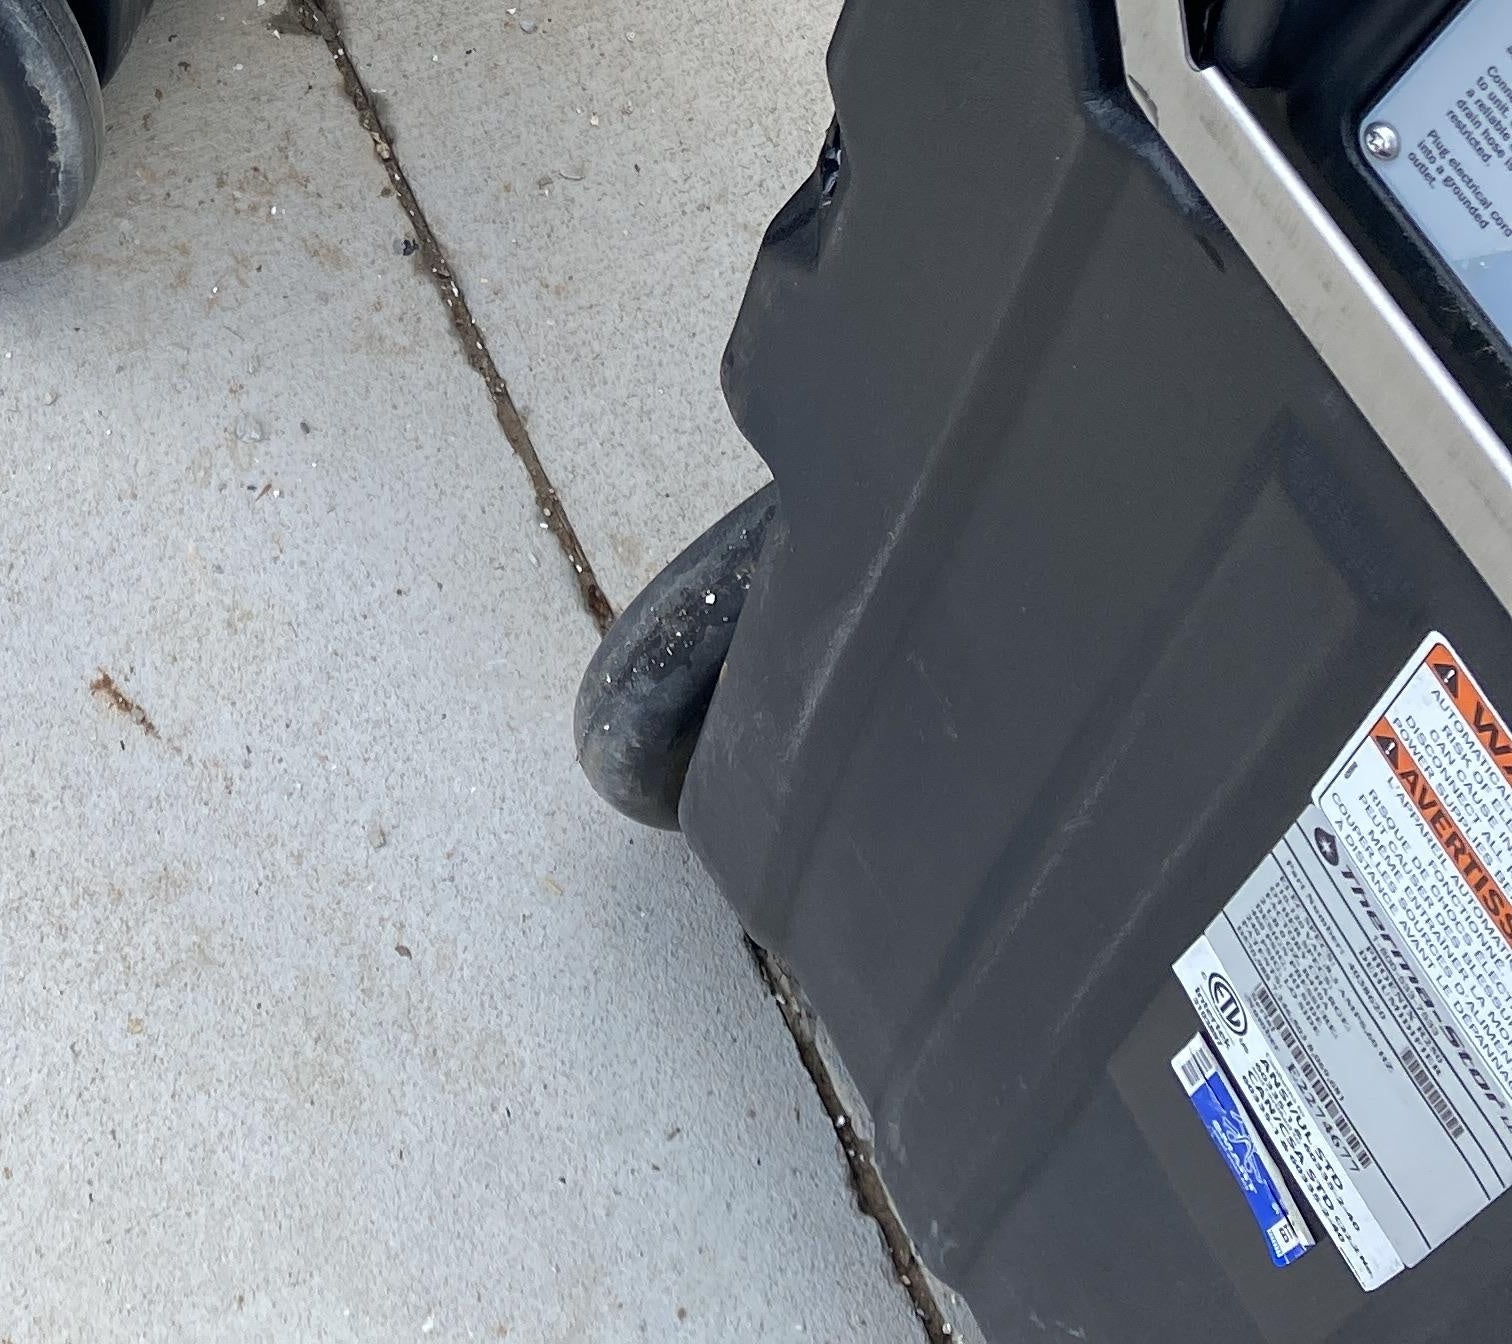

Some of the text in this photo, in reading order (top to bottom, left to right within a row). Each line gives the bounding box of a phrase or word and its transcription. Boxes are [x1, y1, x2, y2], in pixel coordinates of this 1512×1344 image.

[1454, 96, 1483, 130] drain
[1479, 127, 1508, 160] hose
[1464, 86, 1512, 142] a reliable
[1474, 74, 1512, 120] to unit.
[1485, 63, 1512, 103] Conn
[1405, 150, 1439, 190] outlet.
[1416, 139, 1489, 230] into a grounded
[1423, 128, 1452, 161] Plug
[1446, 155, 1493, 211] electrical
[1444, 108, 1494, 167] restricted.
[1390, 715, 1437, 780] POWER
[1433, 780, 1496, 867] SUPPLIES
[1403, 714, 1507, 862] DISCONNECT ALL
[1427, 727, 1456, 767] CAN
[1454, 766, 1500, 830] CAUSE
[1439, 722, 1474, 769] RISK
[1471, 768, 1492, 796] OF
[1284, 858, 1306, 890] Part
[1303, 891, 1346, 955] Number:
[1329, 789, 1376, 859] COUPER
[1373, 860, 1398, 895] LES
[1396, 895, 1454, 980] SOURCES
[1343, 832, 1400, 915] DISTANCE
[1398, 917, 1435, 970] AVANT
[1435, 973, 1454, 998] LE
[1357, 792, 1389, 838] PEUT
[1386, 838, 1435, 910] CAUSER
[1433, 911, 1462, 950] DES
[1365, 787, 1512, 1010] RISQUE DE CHOCS ÉLECT
[1384, 774, 1512, 965] L'APPAREIL AUTOMATI
[1193, 985, 1233, 1050] Intertek
[1338, 862, 1503, 1109] Therma-Stor
[1357, 948, 1441, 1076] DEHUMIDIFIER
[1363, 944, 1416, 1022] PHOENIX
[1468, 983, 1488, 1009] LA
[1209, 1117, 1259, 1197] SMART
[1245, 1067, 1307, 1166] CAN/CSA
[1305, 1167, 1336, 1213] STD
[1258, 1054, 1345, 1193] ANSI/UL STD
[1285, 1060, 1360, 1177] E2274677
